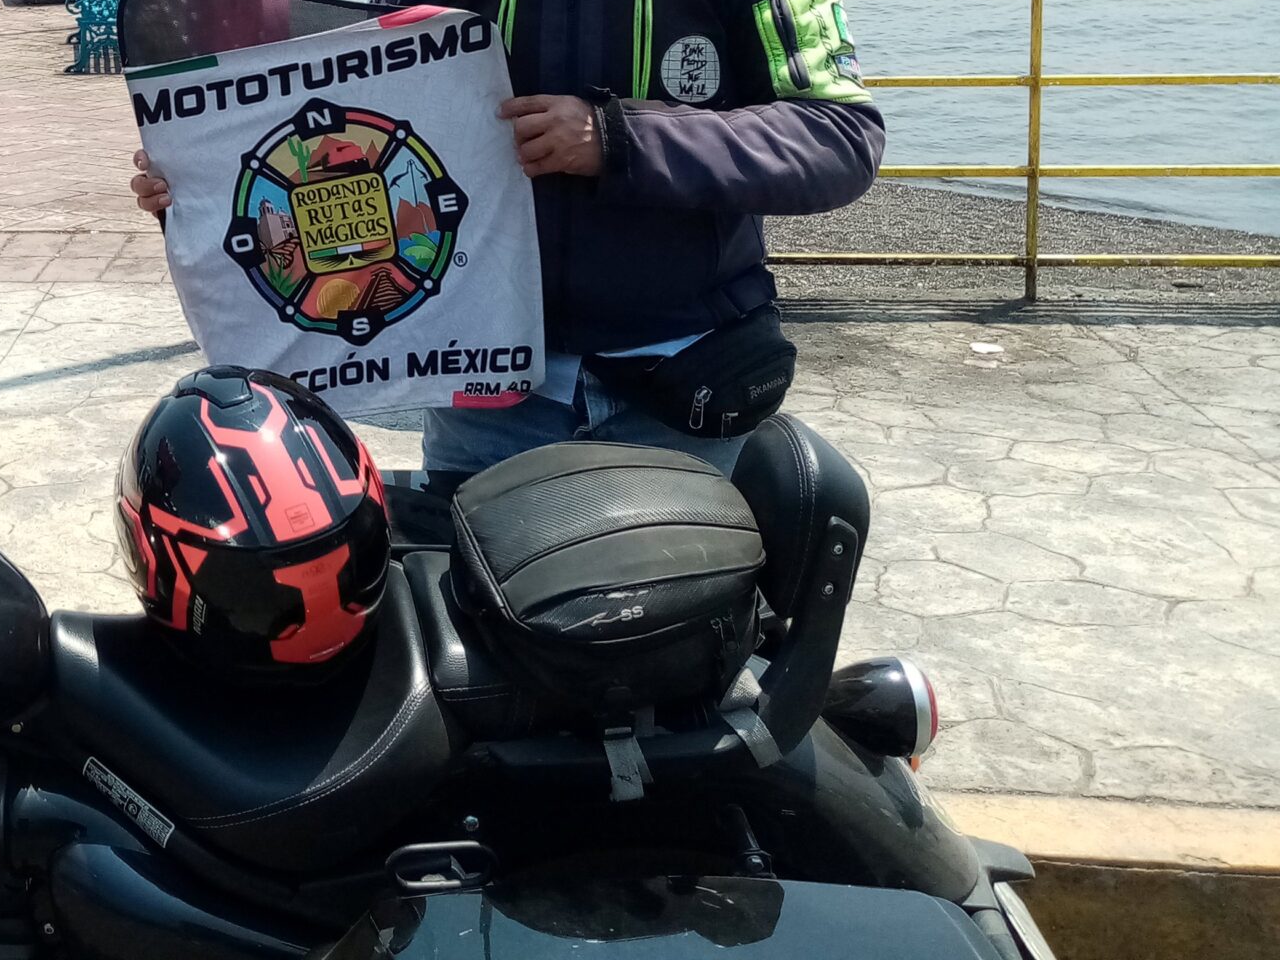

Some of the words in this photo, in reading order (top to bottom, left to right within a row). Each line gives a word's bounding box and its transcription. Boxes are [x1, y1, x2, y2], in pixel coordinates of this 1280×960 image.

[681, 43, 705, 57] PINK
[133, 16, 492, 127] MOTOTURISMO
[679, 81, 707, 100] WALL
[306, 108, 332, 129] N
[438, 193, 458, 213] E
[231, 233, 254, 253] O
[352, 317, 370, 336] S
[407, 340, 532, 377] MÉXICO
[464, 382, 501, 395] RRM
